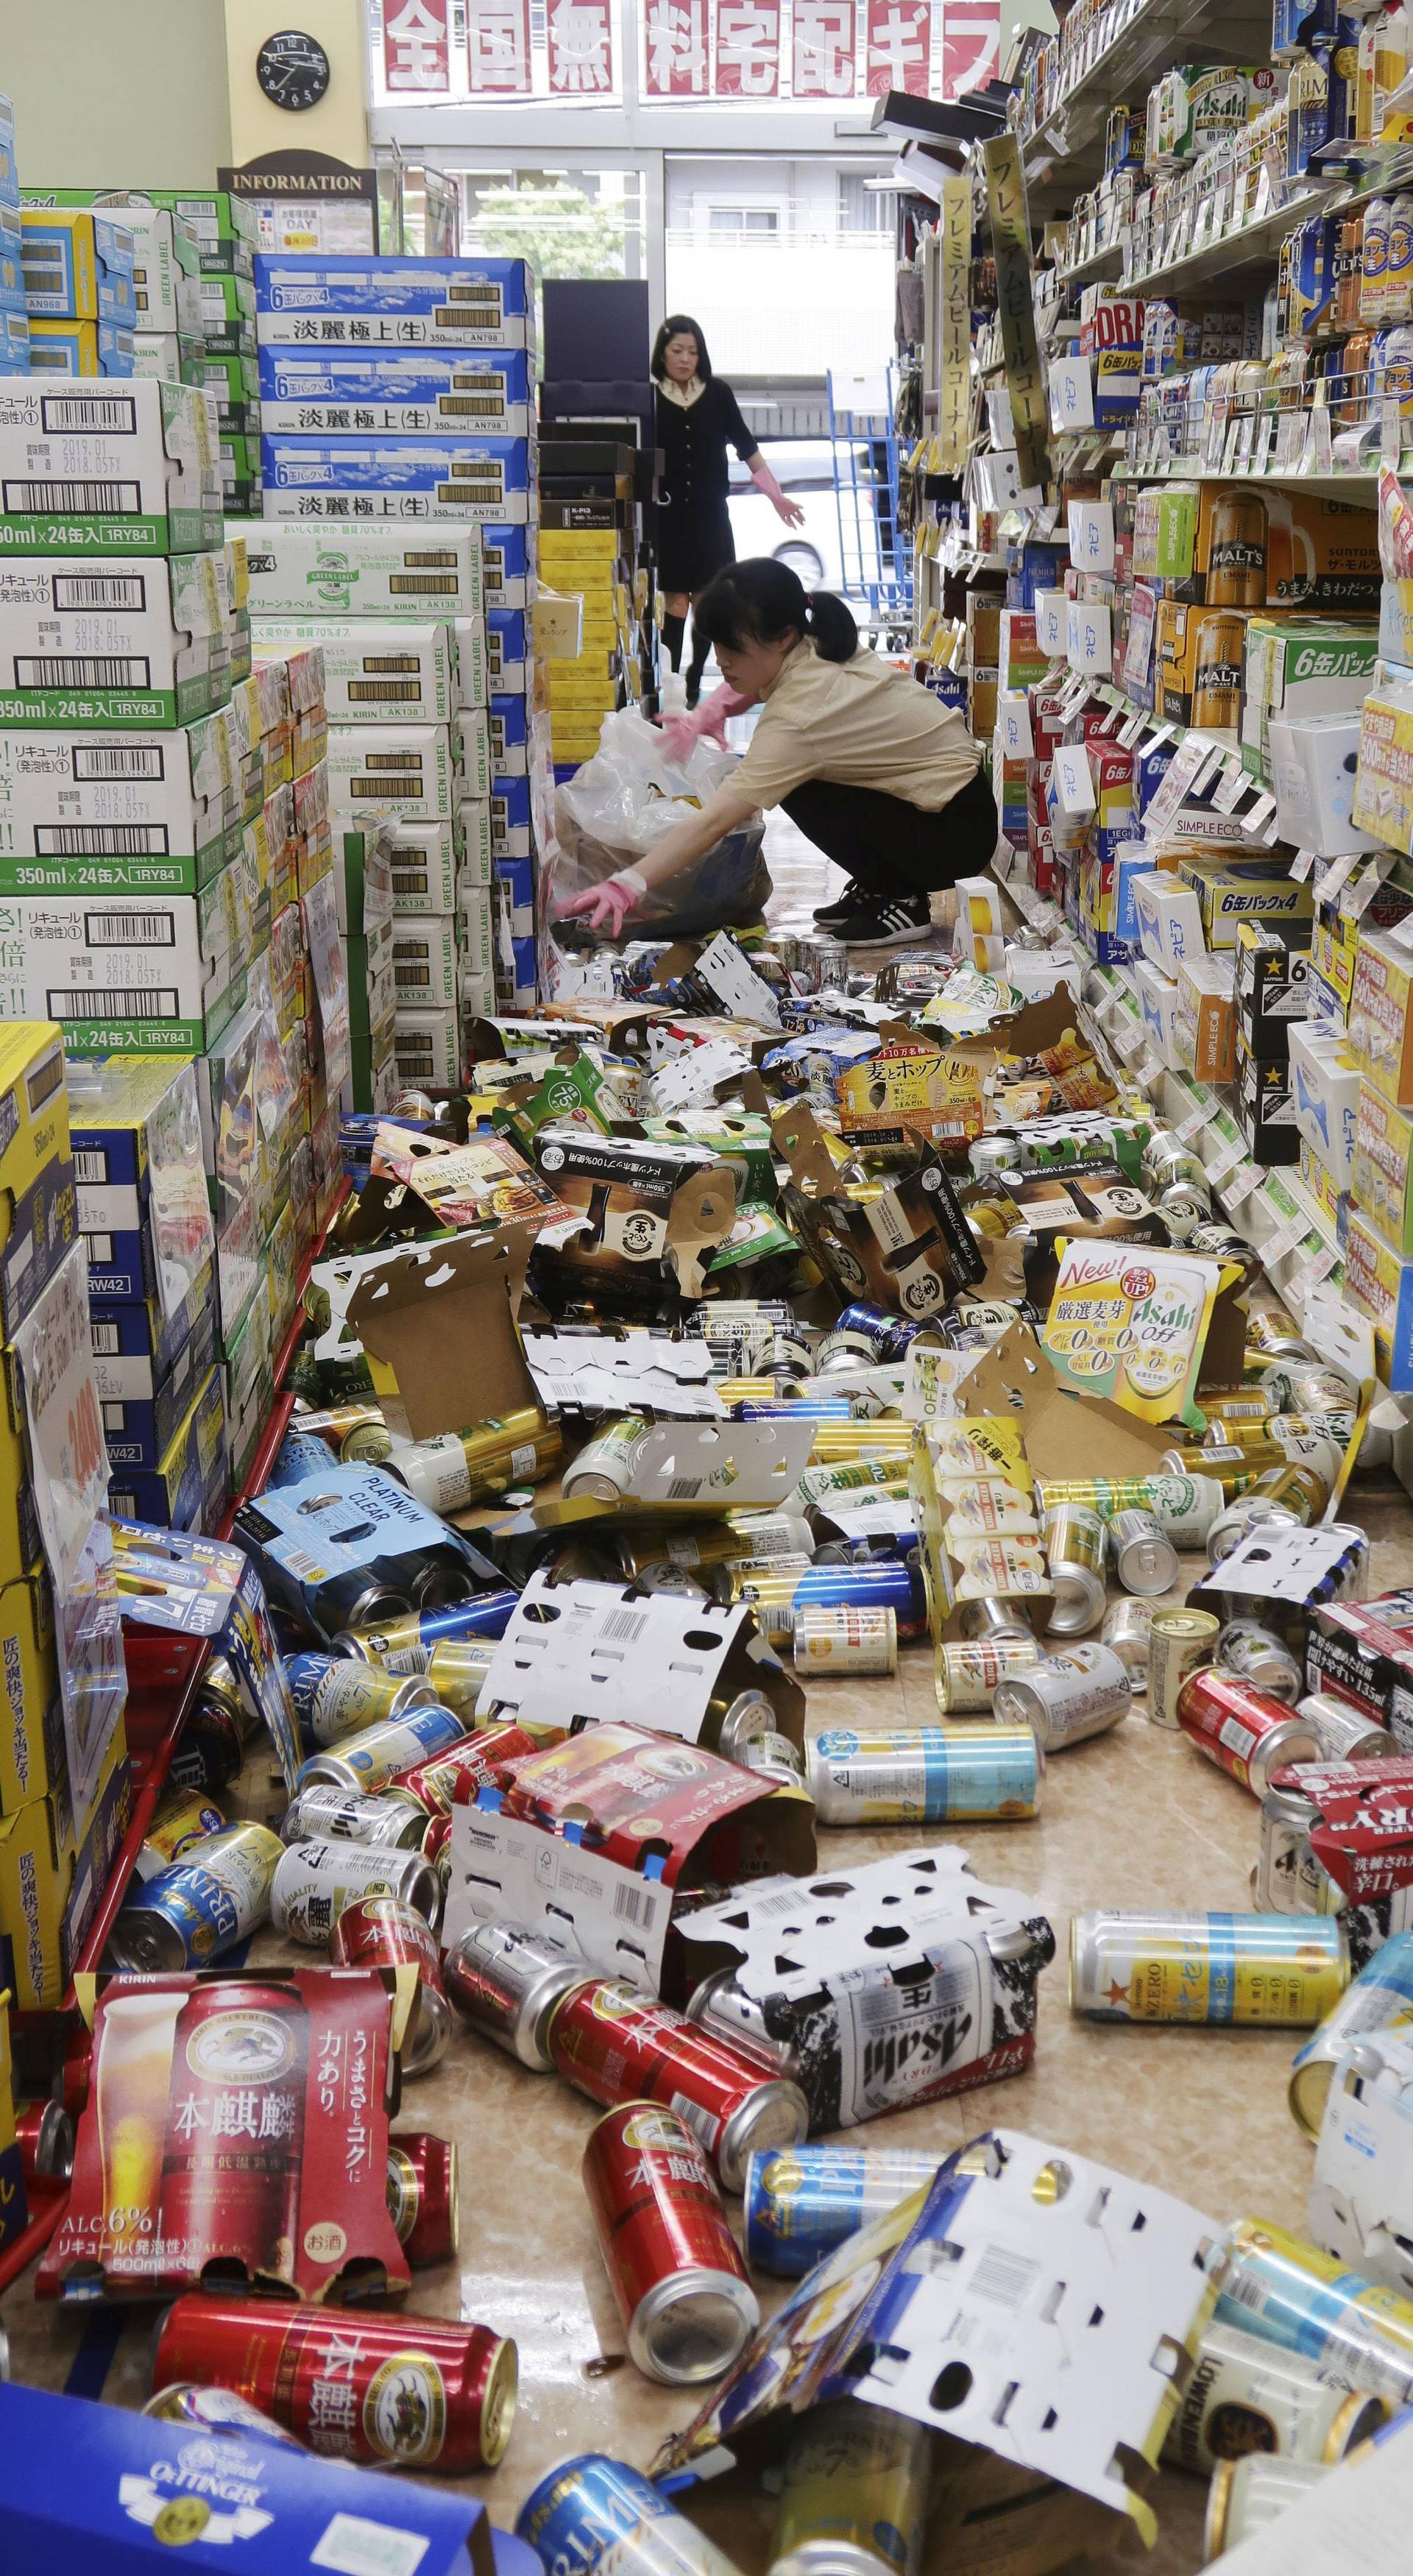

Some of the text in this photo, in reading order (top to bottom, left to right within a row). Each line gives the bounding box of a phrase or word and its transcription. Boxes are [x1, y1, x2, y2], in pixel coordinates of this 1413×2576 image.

[263, 66, 271, 75] 9
[1257, 71, 1271, 88] 新
[269, 80, 275, 89] 8
[313, 81, 320, 89] 4
[279, 90, 286, 99] 7
[291, 94, 299, 103] 6
[1196, 93, 1247, 121] Asahi
[232, 174, 362, 191] INFORMATION
[286, 220, 313, 230] DAY
[162, 270, 171, 306] GREEN
[29, 298, 61, 309] AN968
[293, 319, 427, 341] 淡麗極上(生)
[470, 333, 498, 342] AN798
[298, 408, 502, 430] 淡麗極上(生) AN798
[63, 439, 107, 456] 2019.01
[297, 495, 500, 518] 淡麗極上(生) AN798
[106, 529, 149, 542] 1RY84
[1231, 541, 1246, 551] The
[1212, 548, 1263, 567] MALT'S
[333, 571, 355, 581] LABEL
[472, 576, 480, 609] GREEN
[1277, 580, 1380, 598] うまみ、きわだつ。
[427, 600, 456, 609] AK138
[75, 618, 118, 635] 2019.01
[474, 670, 482, 702] GREEN
[116, 704, 157, 715] 1RY84
[438, 685, 446, 716] GREEN
[353, 708, 419, 718] KIRIN AK138
[15, 746, 68, 758] リキュール
[478, 760, 486, 791] GREEN
[94, 786, 137, 802] 2019.01
[439, 779, 447, 813] GREEN
[1177, 818, 1216, 832] SIMPLE
[1217, 823, 1243, 836] ECO
[135, 869, 176, 880] 1RY84
[443, 875, 452, 908] GREEN
[394, 899, 425, 908] AK138
[28, 912, 81, 924] リキュール
[1171, 918, 1185, 960] ネピア
[106, 953, 147, 969] 2019.01
[1291, 959, 1307, 980] 6
[445, 966, 453, 999] GREEN
[397, 991, 427, 1000] AK138
[146, 1033, 185, 1044] 1RY84
[1207, 1010, 1219, 1066] SIMPLE ECO
[865, 1055, 946, 1083] 麦とホップ
[568, 1153, 662, 1176] ドイツ産ホップ100%使用
[634, 1220, 648, 1235] 生
[1060, 1256, 1127, 1289] New!
[1124, 1282, 1148, 1297] UP!
[1055, 1300, 1127, 1322] 厳選麦芽
[1133, 1298, 1197, 1331] Asahi
[1141, 1326, 1183, 1342] Off
[348, 1492, 391, 1522] CLEAR
[362, 1476, 425, 1524] PLATINUM
[1308, 1629, 1374, 1680] 世界が認めた技術
[119, 1973, 157, 1984] KIRIN
[902, 1983, 932, 2009] 生
[863, 2012, 972, 2087] Asahi
[316, 2030, 342, 2119] 力あり。
[346, 2030, 369, 2184] うまさとコクに
[307, 2233, 343, 2253] お酒
